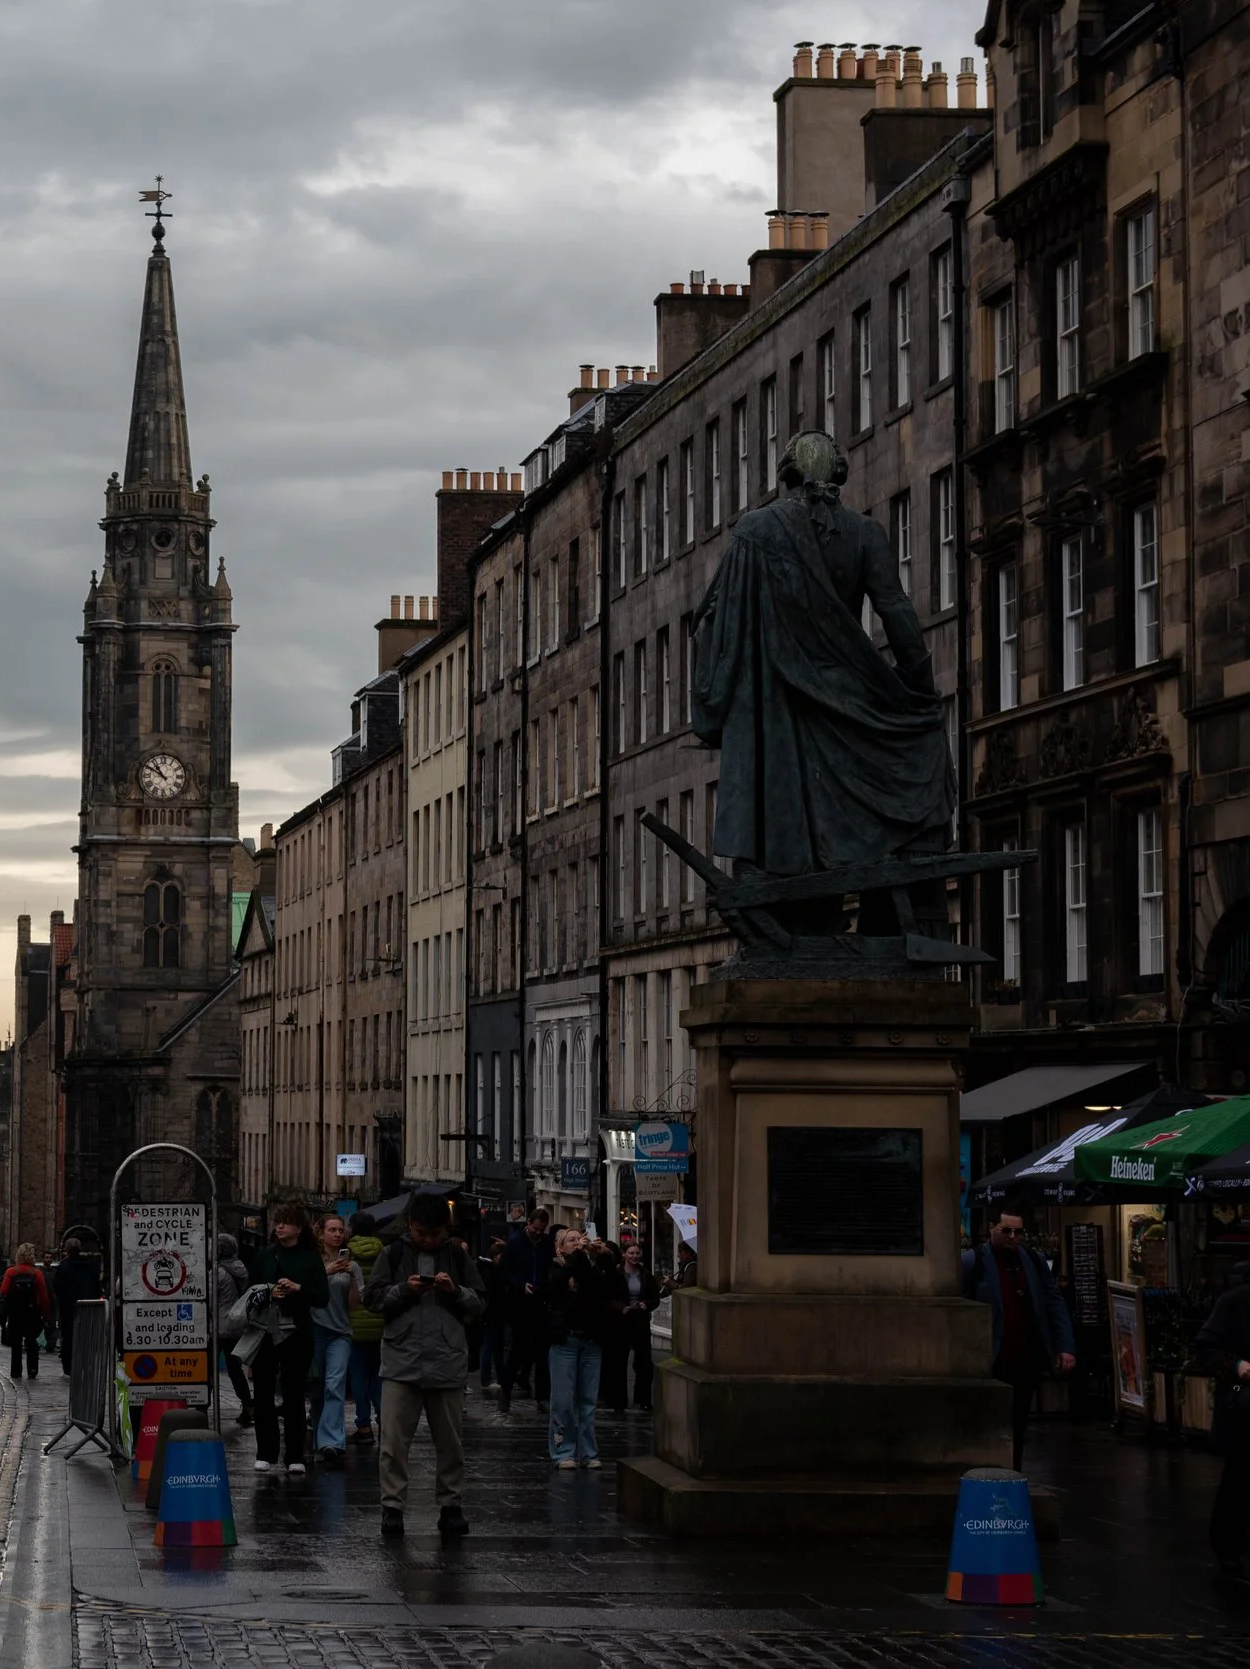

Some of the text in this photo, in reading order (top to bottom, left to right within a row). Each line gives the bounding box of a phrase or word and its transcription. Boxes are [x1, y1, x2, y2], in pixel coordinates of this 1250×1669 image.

[638, 1131, 670, 1146] fringe
[565, 1163, 587, 1175] 166
[1110, 1155, 1156, 1181] Heineken
[134, 1219, 193, 1229] and CYCLE
[138, 1232, 190, 1246] ZONE
[136, 1308, 173, 1318] Except
[135, 1322, 195, 1333] and loading
[126, 1335, 205, 1345] 6.30-10.30am
[164, 1356, 198, 1367] At any
[170, 1369, 193, 1378] time
